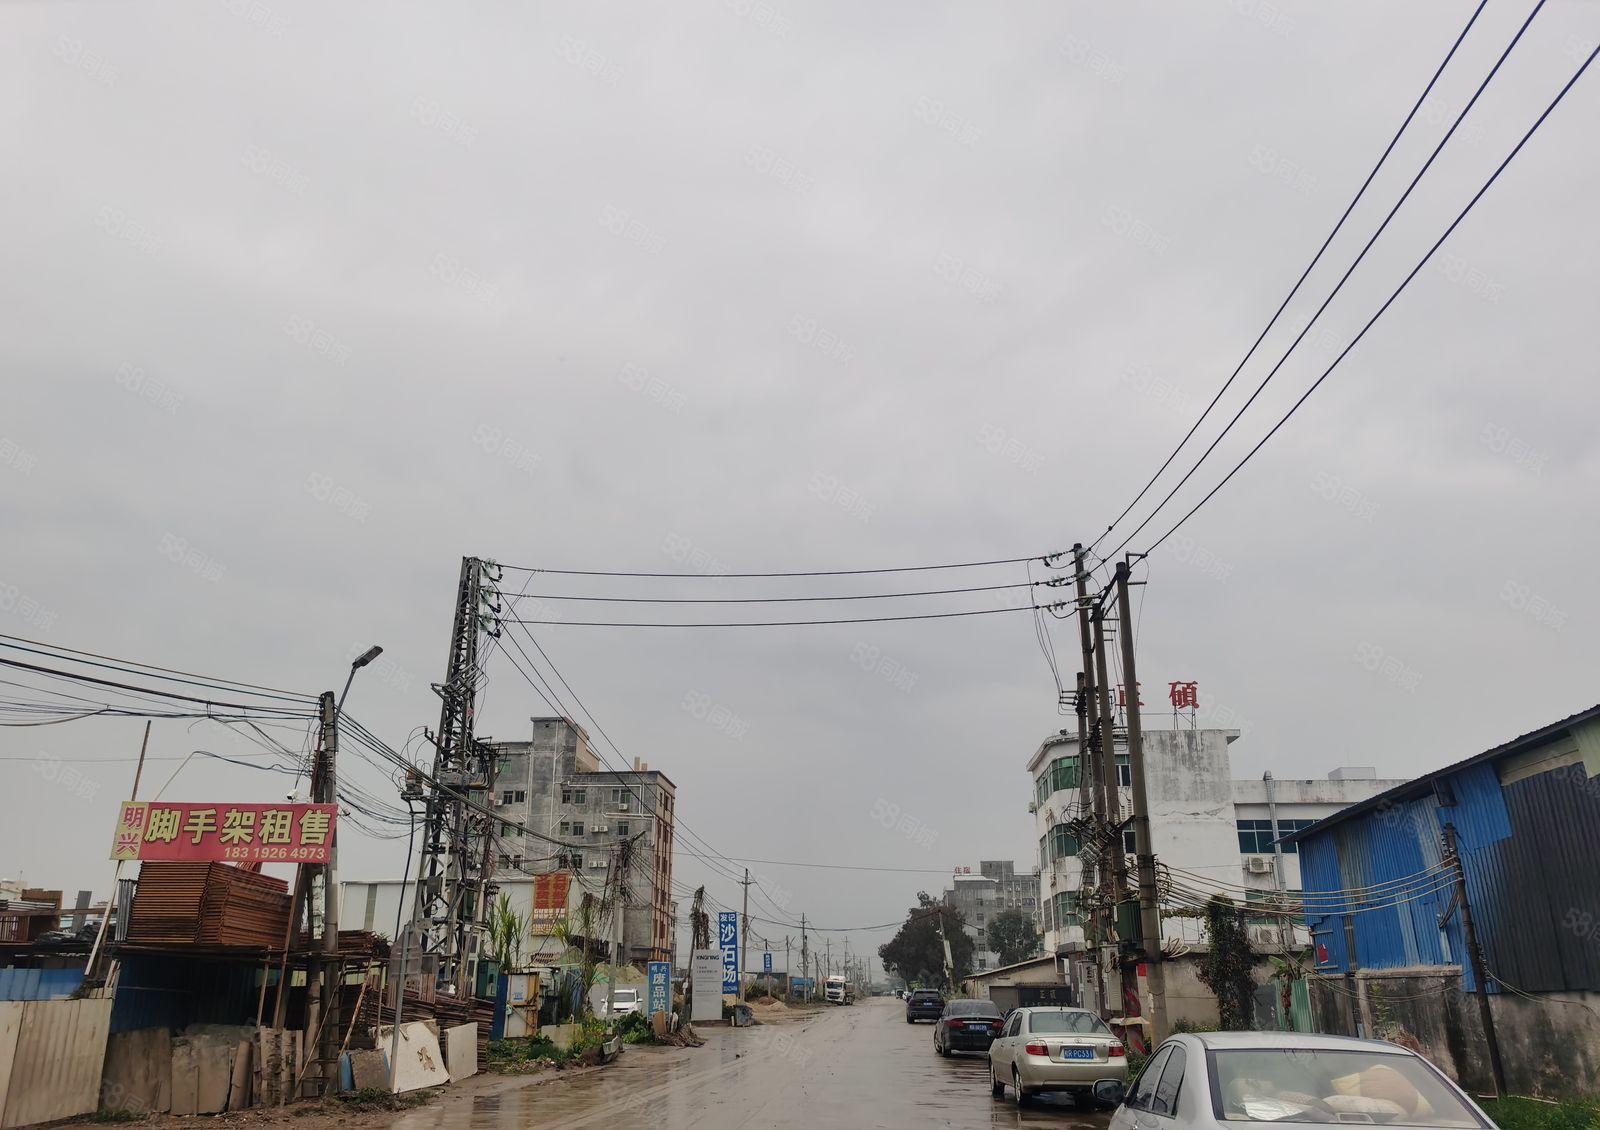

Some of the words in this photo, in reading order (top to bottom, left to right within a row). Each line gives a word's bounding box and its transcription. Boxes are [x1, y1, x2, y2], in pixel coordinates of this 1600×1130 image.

[115, 806, 145, 856] 明兴
[144, 807, 331, 846] 脚手架租售
[224, 847, 249, 859] 183
[253, 847, 287, 859] 1926
[289, 848, 325, 860] 4973
[720, 913, 736, 922] 发记
[720, 923, 737, 983] 沙石场
[652, 973, 666, 1010] 废品站
